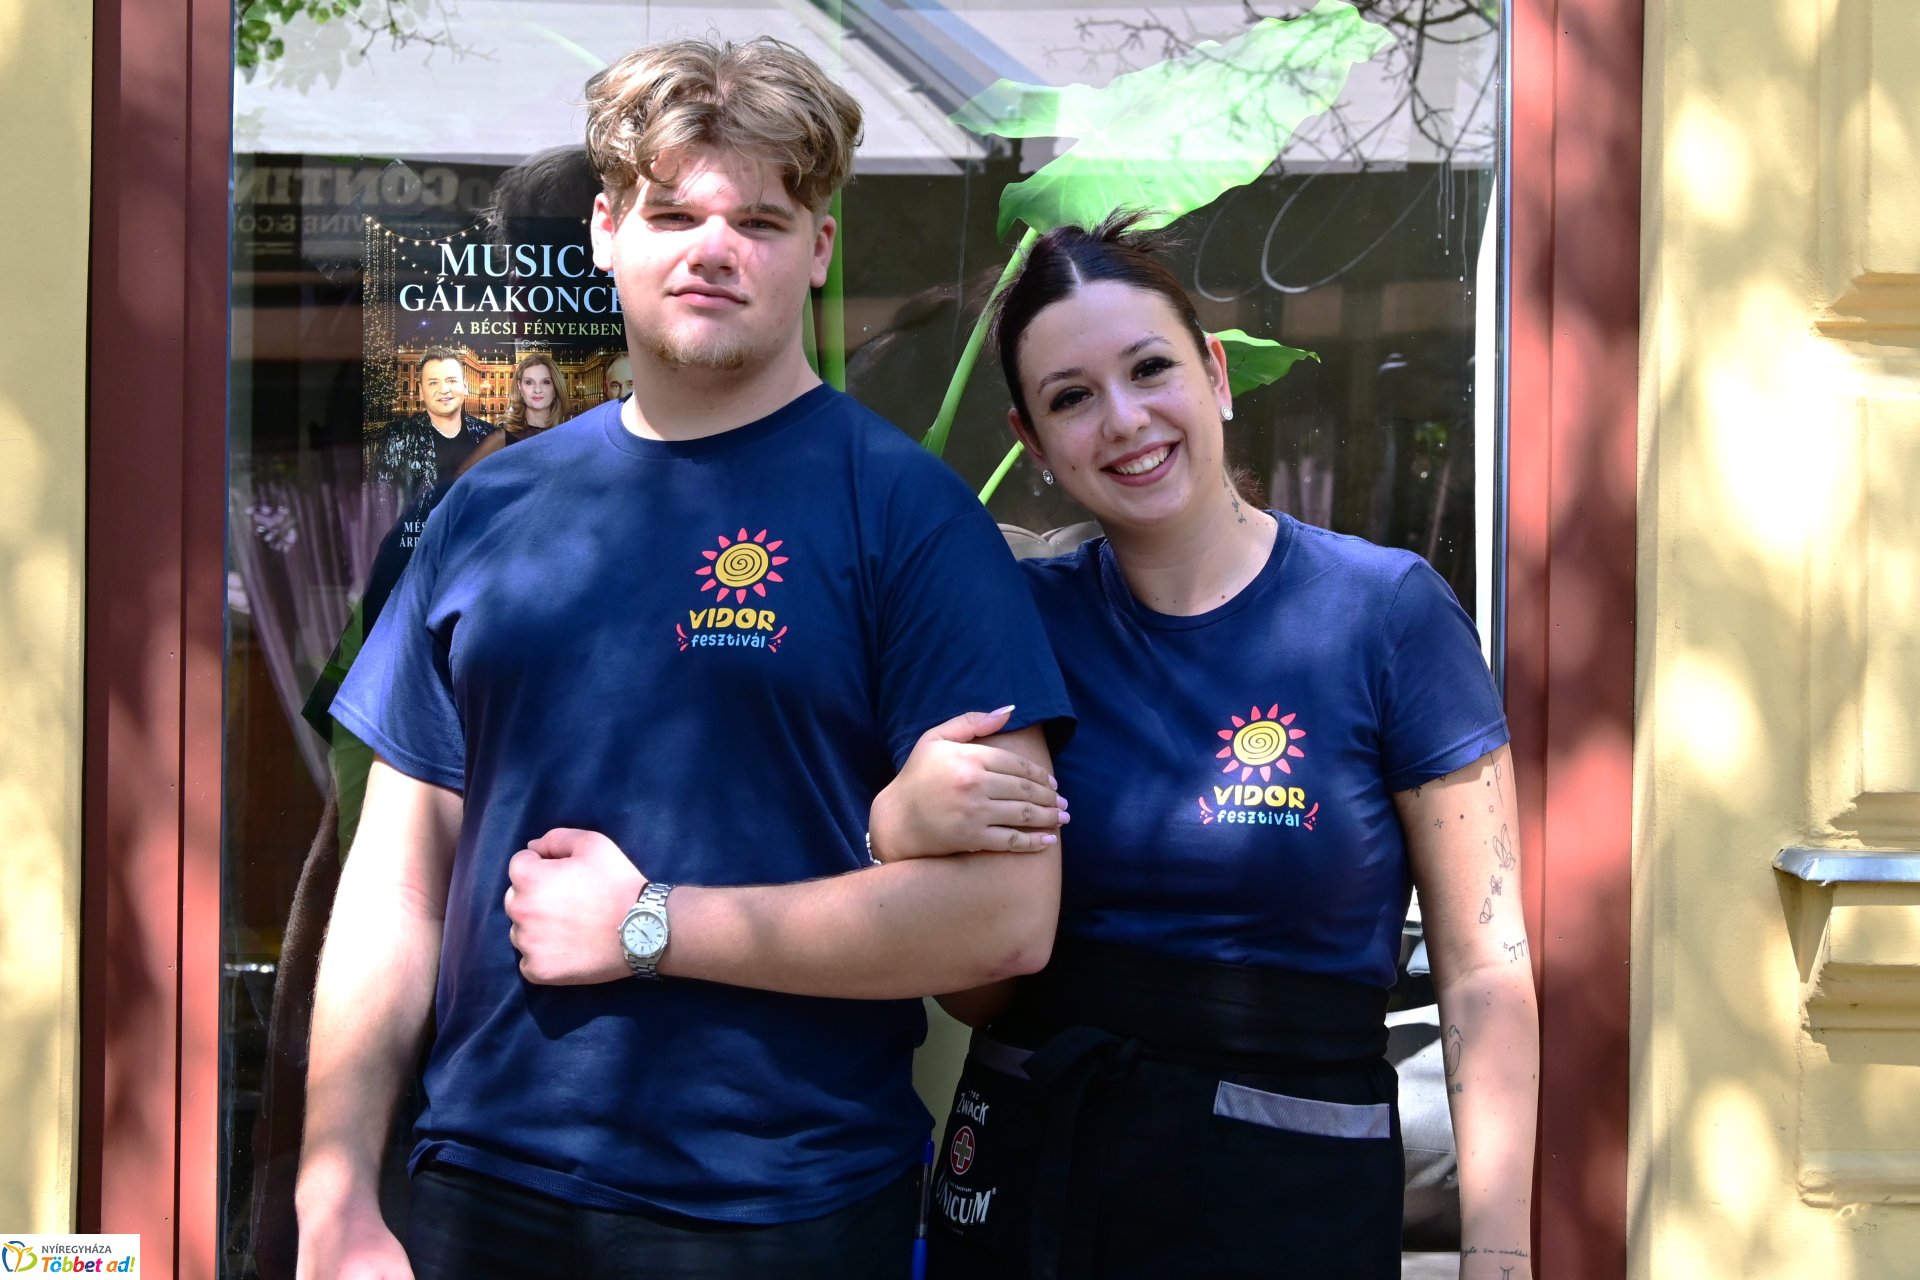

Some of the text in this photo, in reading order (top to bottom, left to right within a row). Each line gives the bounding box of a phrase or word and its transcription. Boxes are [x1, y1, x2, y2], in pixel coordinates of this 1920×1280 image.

[453, 318, 622, 336] A BÉCSI FÉNYEKBEN
[689, 607, 776, 631] VIDOR
[691, 632, 766, 648] fesztivál
[1213, 785, 1306, 809] VIDOR
[1217, 810, 1300, 827] fesztivál
